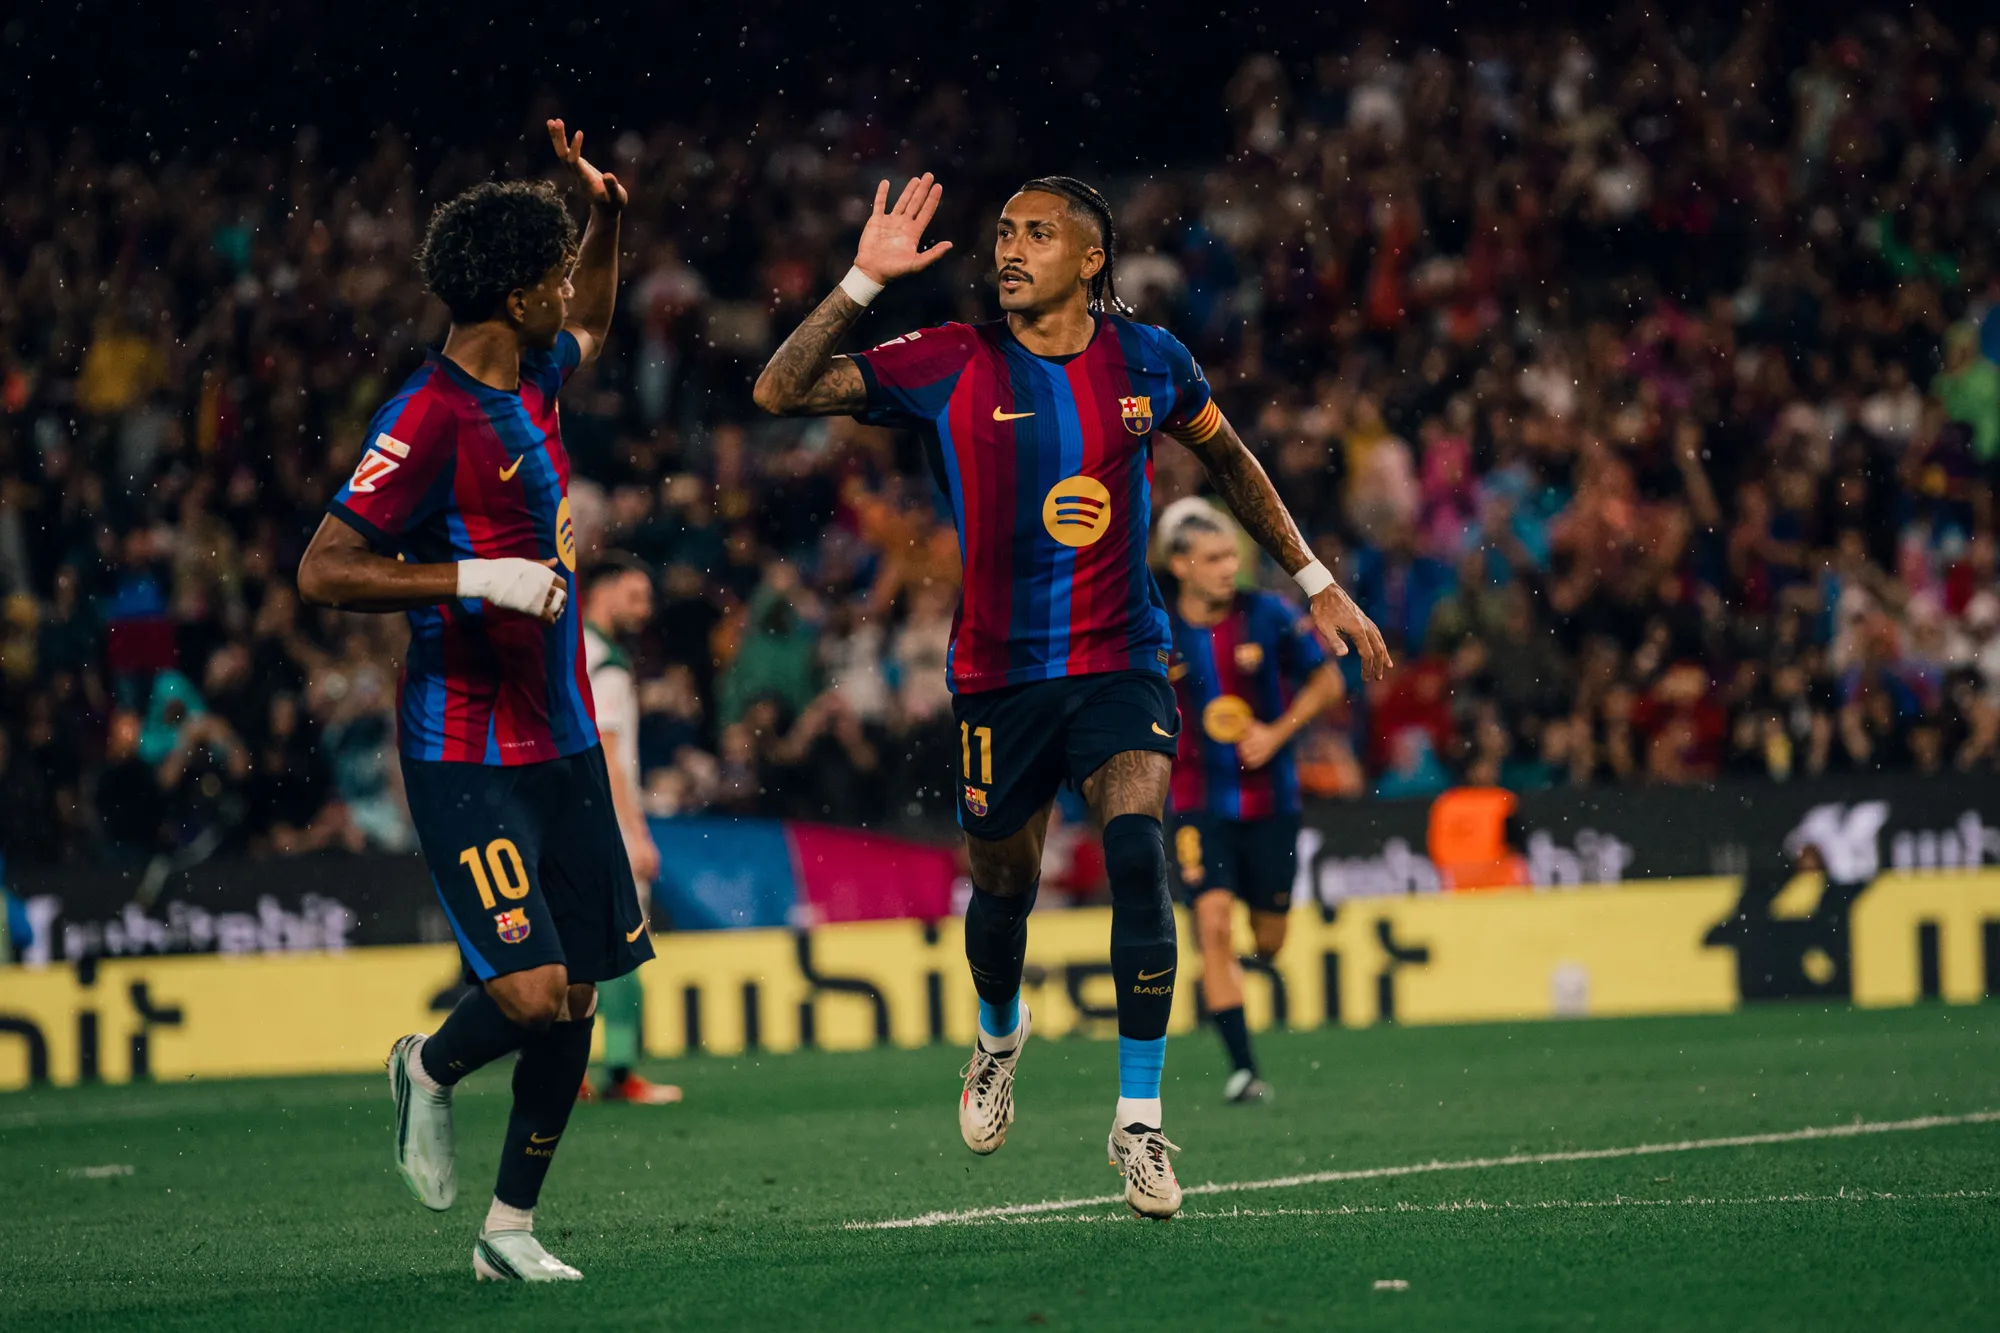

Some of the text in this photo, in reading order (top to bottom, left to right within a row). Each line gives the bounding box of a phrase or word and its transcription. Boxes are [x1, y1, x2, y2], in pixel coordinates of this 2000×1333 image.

[960, 720, 992, 784] 11
[459, 838, 530, 910] 10
[1133, 985, 1172, 997] BARÇA
